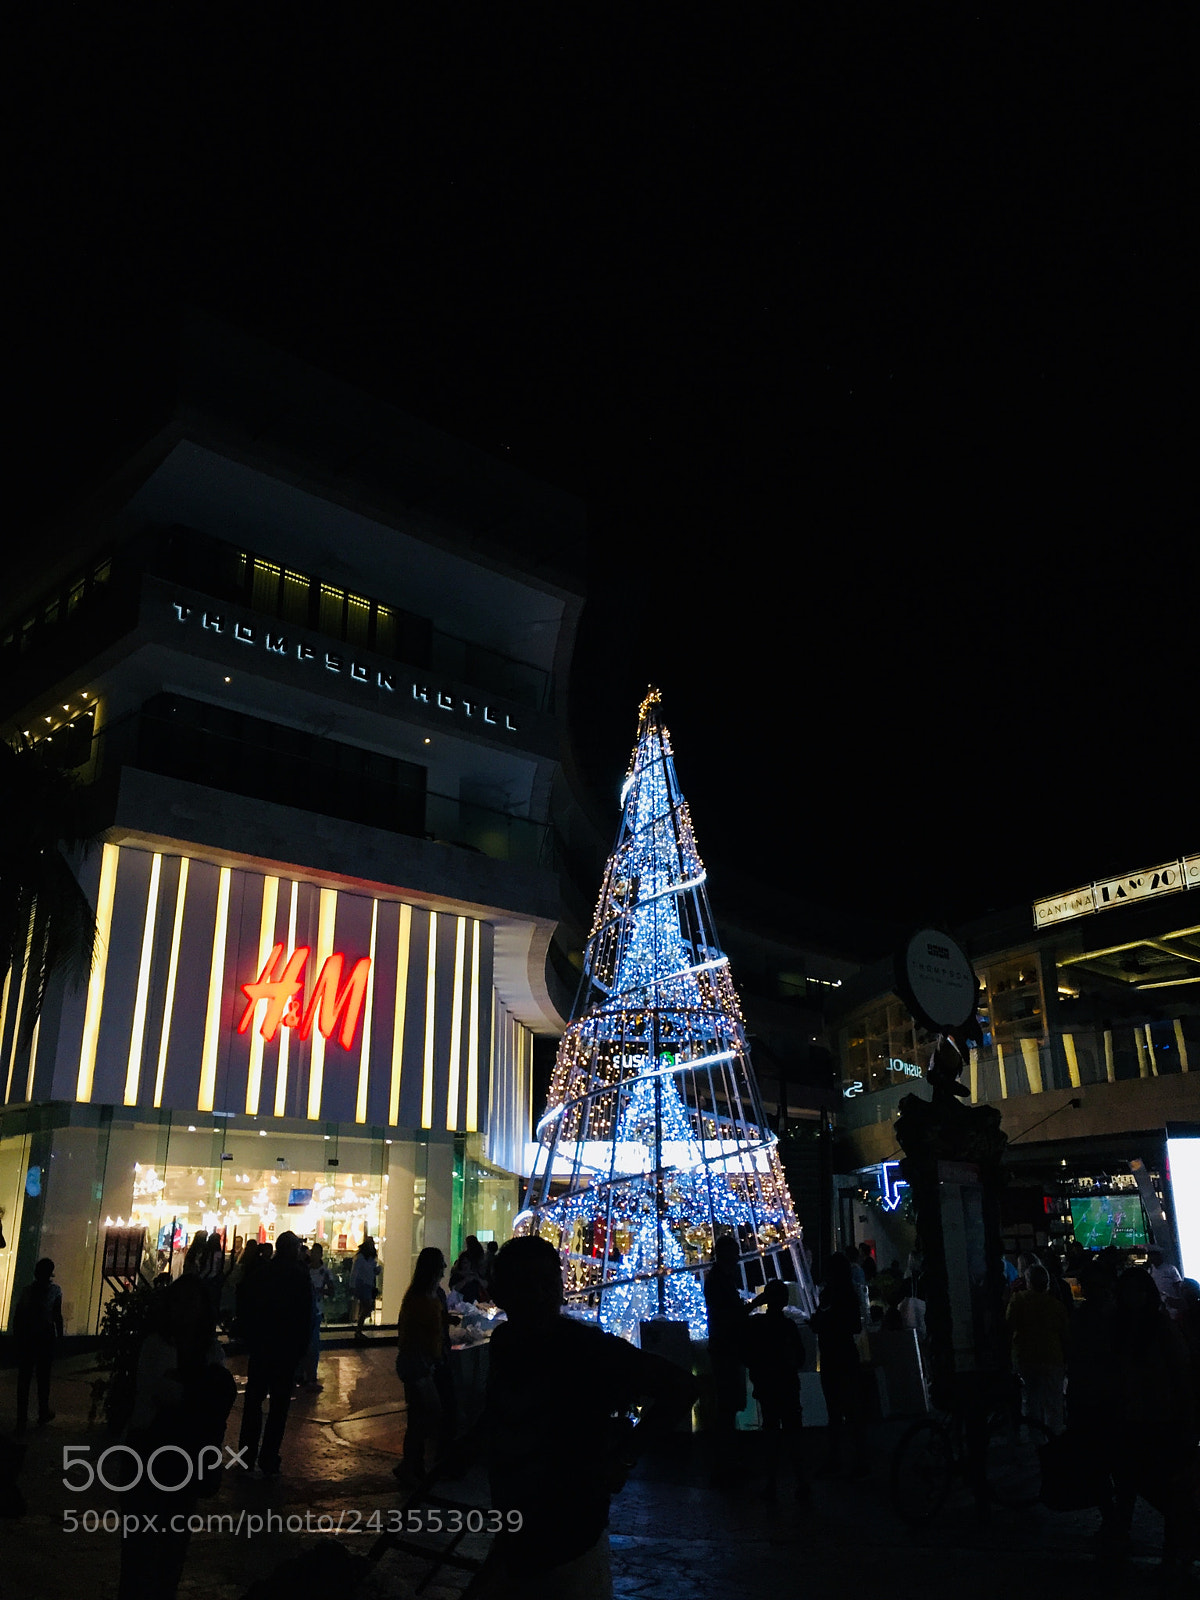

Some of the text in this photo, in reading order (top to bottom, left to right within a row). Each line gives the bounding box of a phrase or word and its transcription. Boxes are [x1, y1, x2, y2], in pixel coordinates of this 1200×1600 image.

[172, 601, 521, 732] THOMPSON HOTEL
[1038, 896, 1092, 919] CANTINA
[237, 942, 372, 1052] H&M
